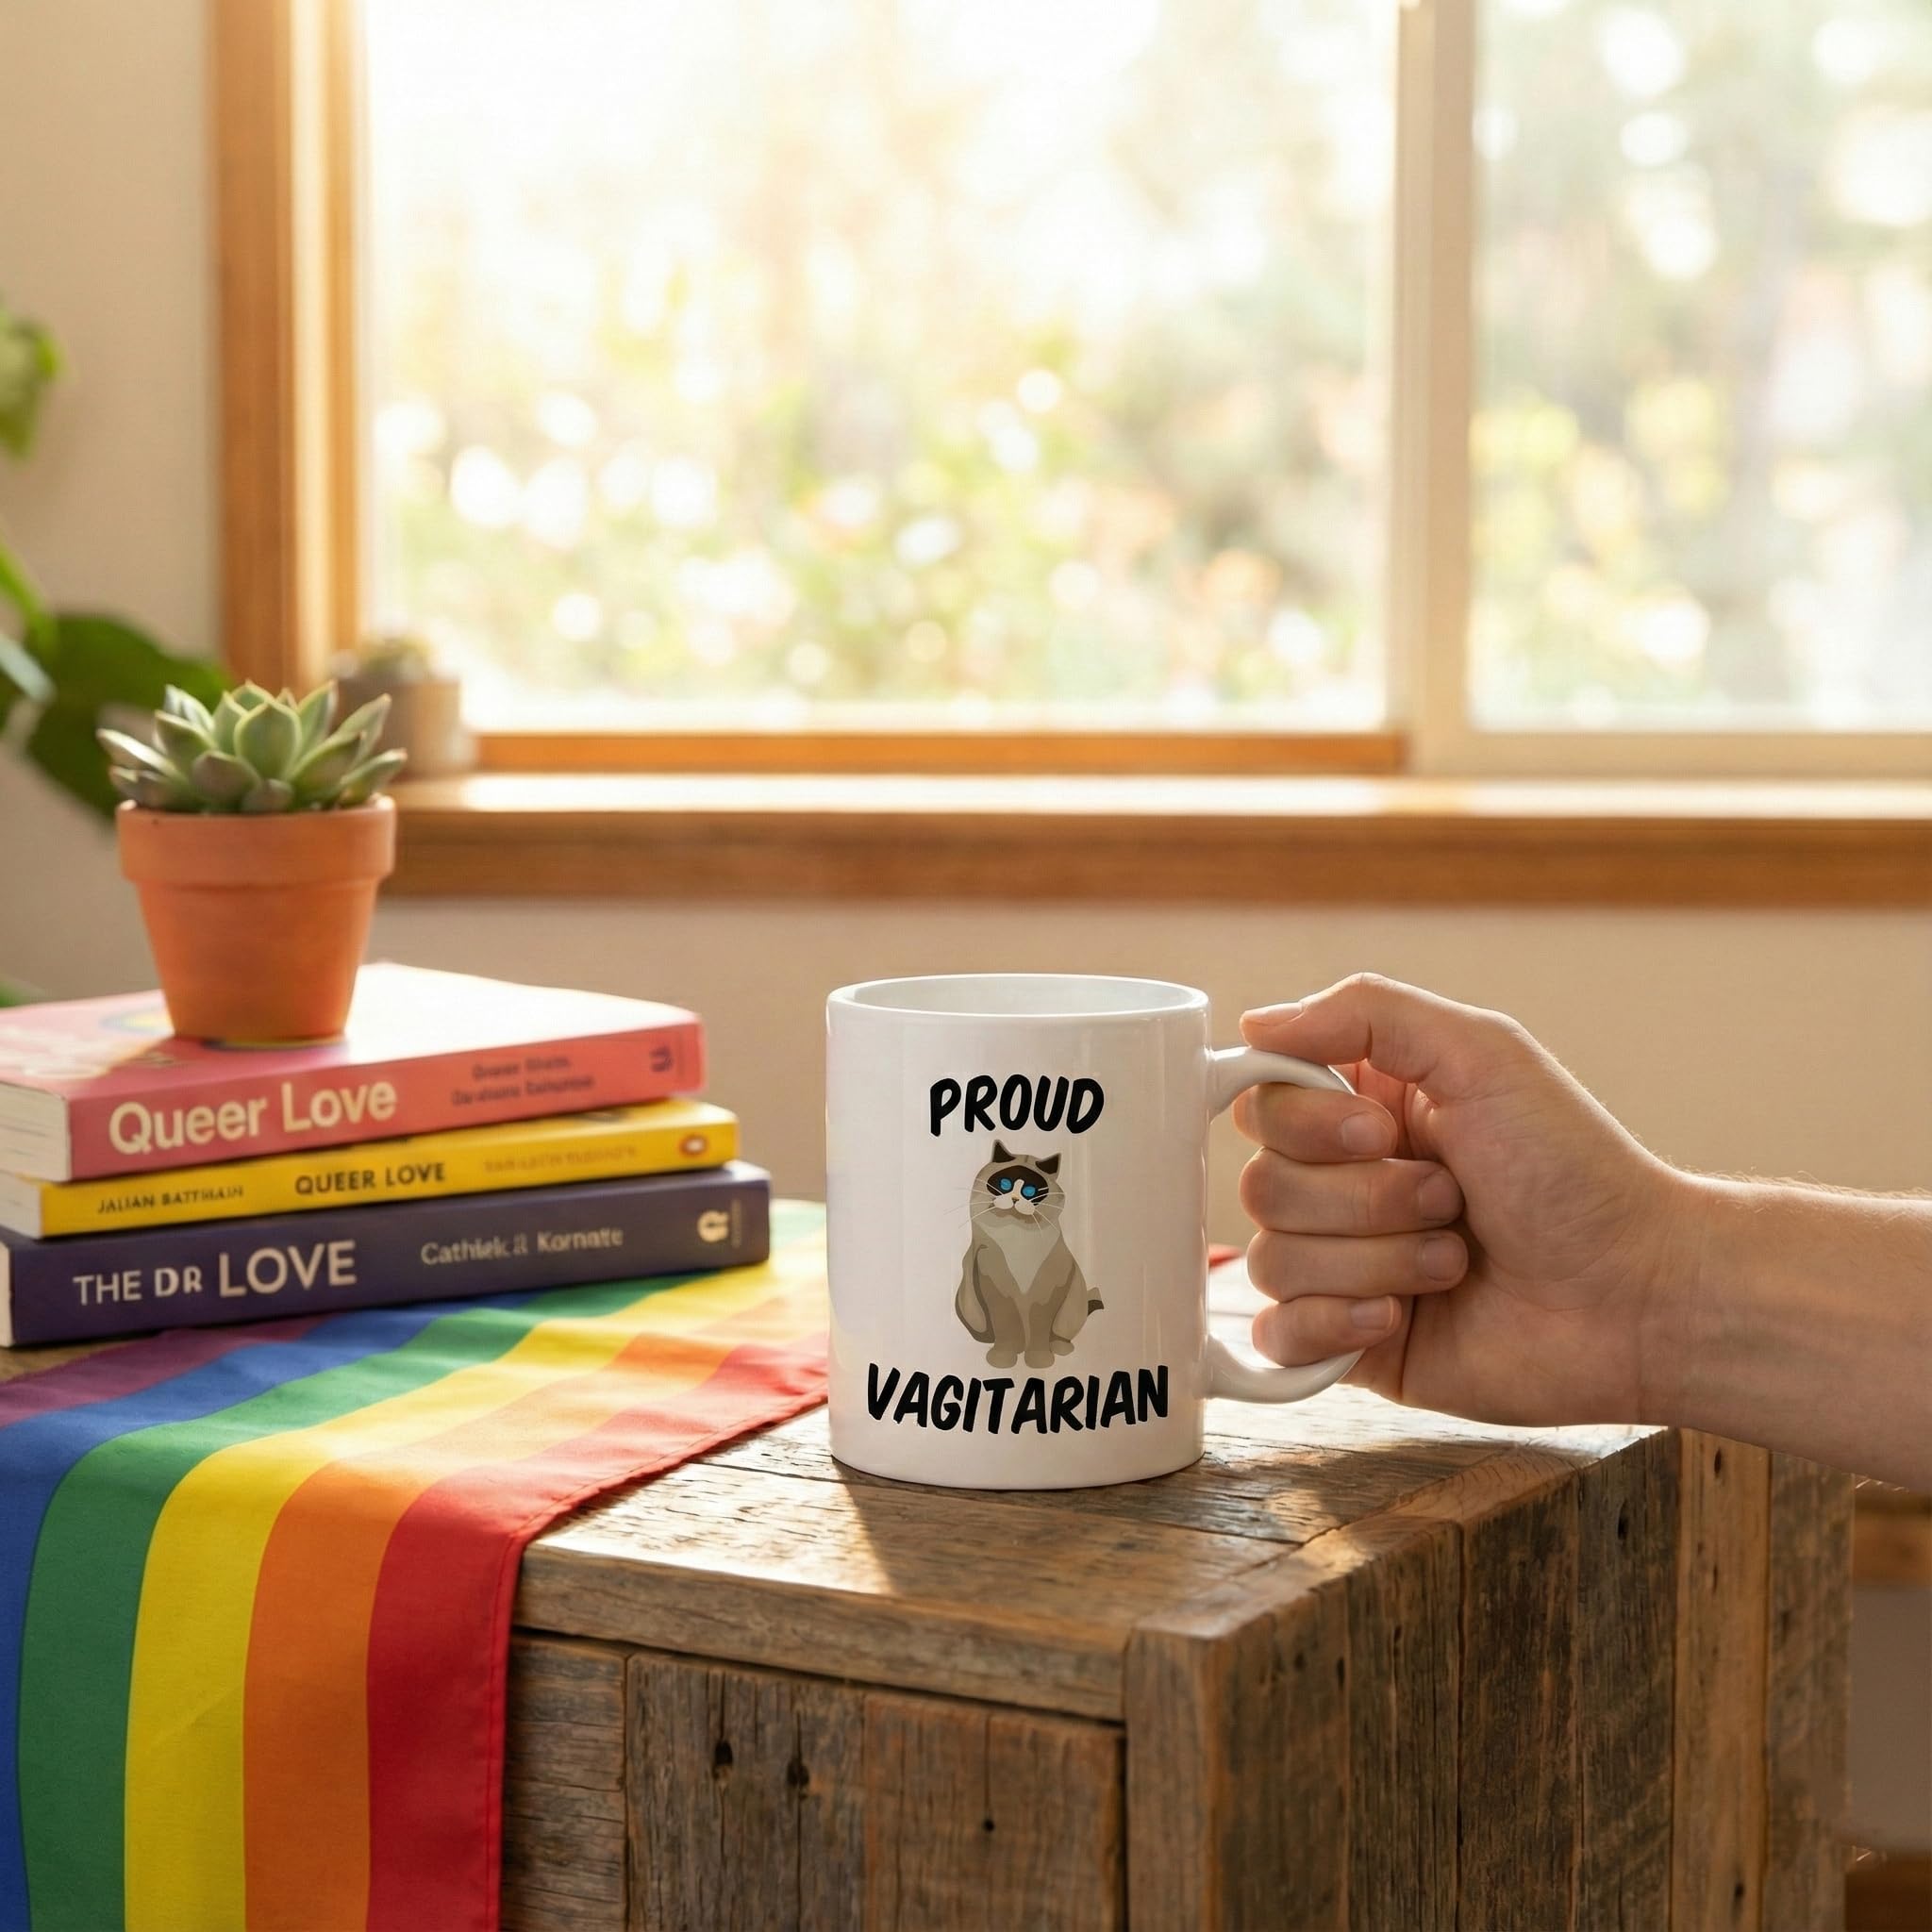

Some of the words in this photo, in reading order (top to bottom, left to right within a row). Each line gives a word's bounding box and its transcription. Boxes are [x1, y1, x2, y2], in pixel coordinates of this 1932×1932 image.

[108, 1101, 267, 1155] Queer
[282, 1081, 397, 1132] Love
[929, 1074, 1105, 1137] PROUD
[295, 1169, 376, 1195] QUEER
[385, 1162, 445, 1187] LOVE
[73, 1270, 142, 1306] THE
[155, 1266, 203, 1297] DR
[219, 1240, 357, 1298] LOVE
[867, 1362, 1169, 1435] VAGITARIAN
